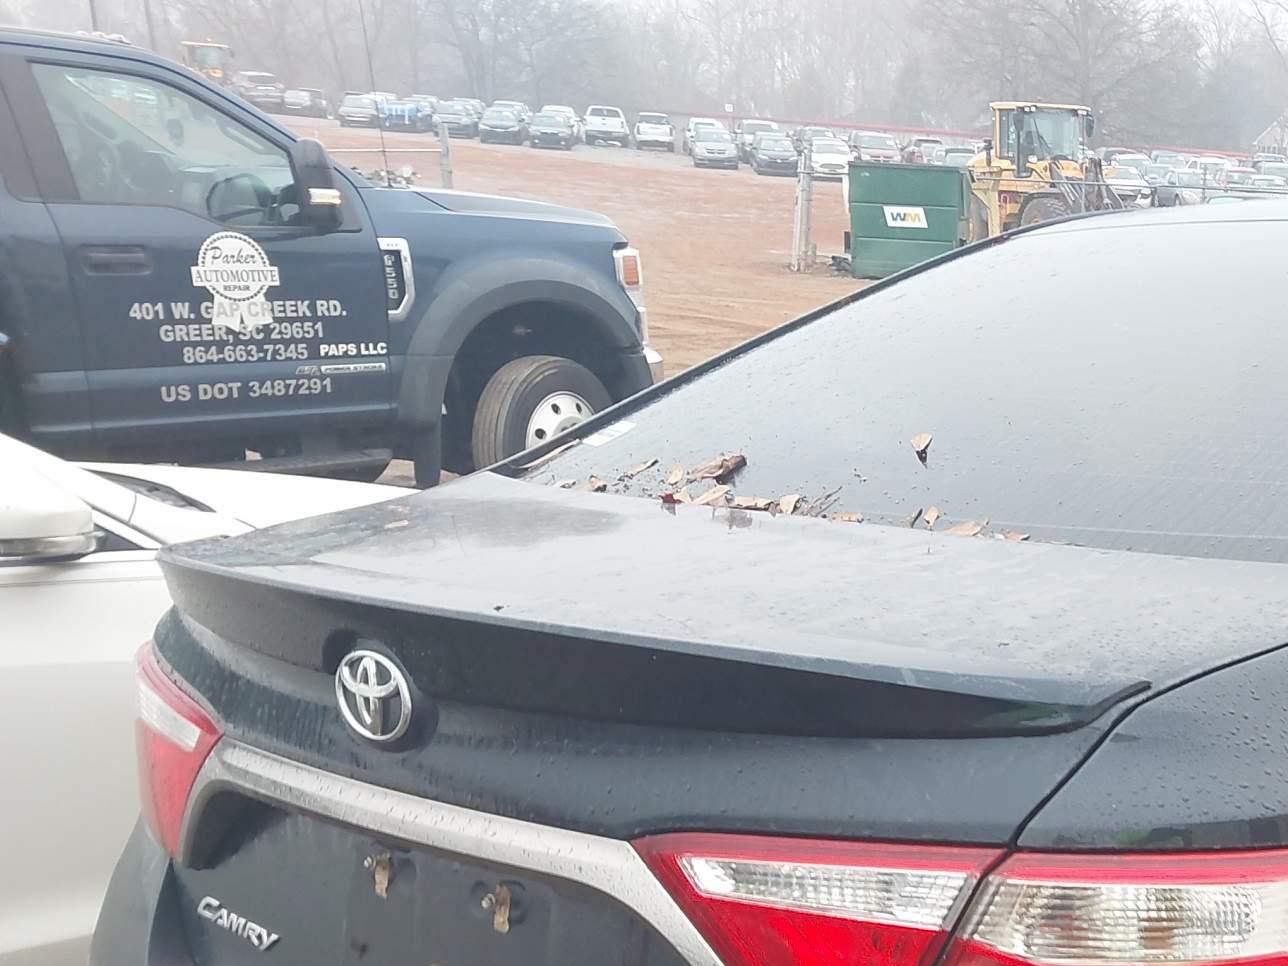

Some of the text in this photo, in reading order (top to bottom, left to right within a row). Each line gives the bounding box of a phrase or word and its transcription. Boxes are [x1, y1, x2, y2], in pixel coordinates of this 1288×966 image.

[890, 211, 922, 222] WM
[210, 246, 257, 266] Parker
[195, 269, 279, 284] AUTOMOTIVE
[223, 284, 251, 293] REPAIR
[129, 299, 348, 320] 401 W. GAP CREEK RD.
[159, 321, 325, 344] GREER, SC 29651
[183, 344, 309, 364] 864-663-7345
[319, 342, 388, 357] PAPS LLC
[160, 377, 333, 403] US DOT 3487291
[196, 895, 281, 951] CAMRY
